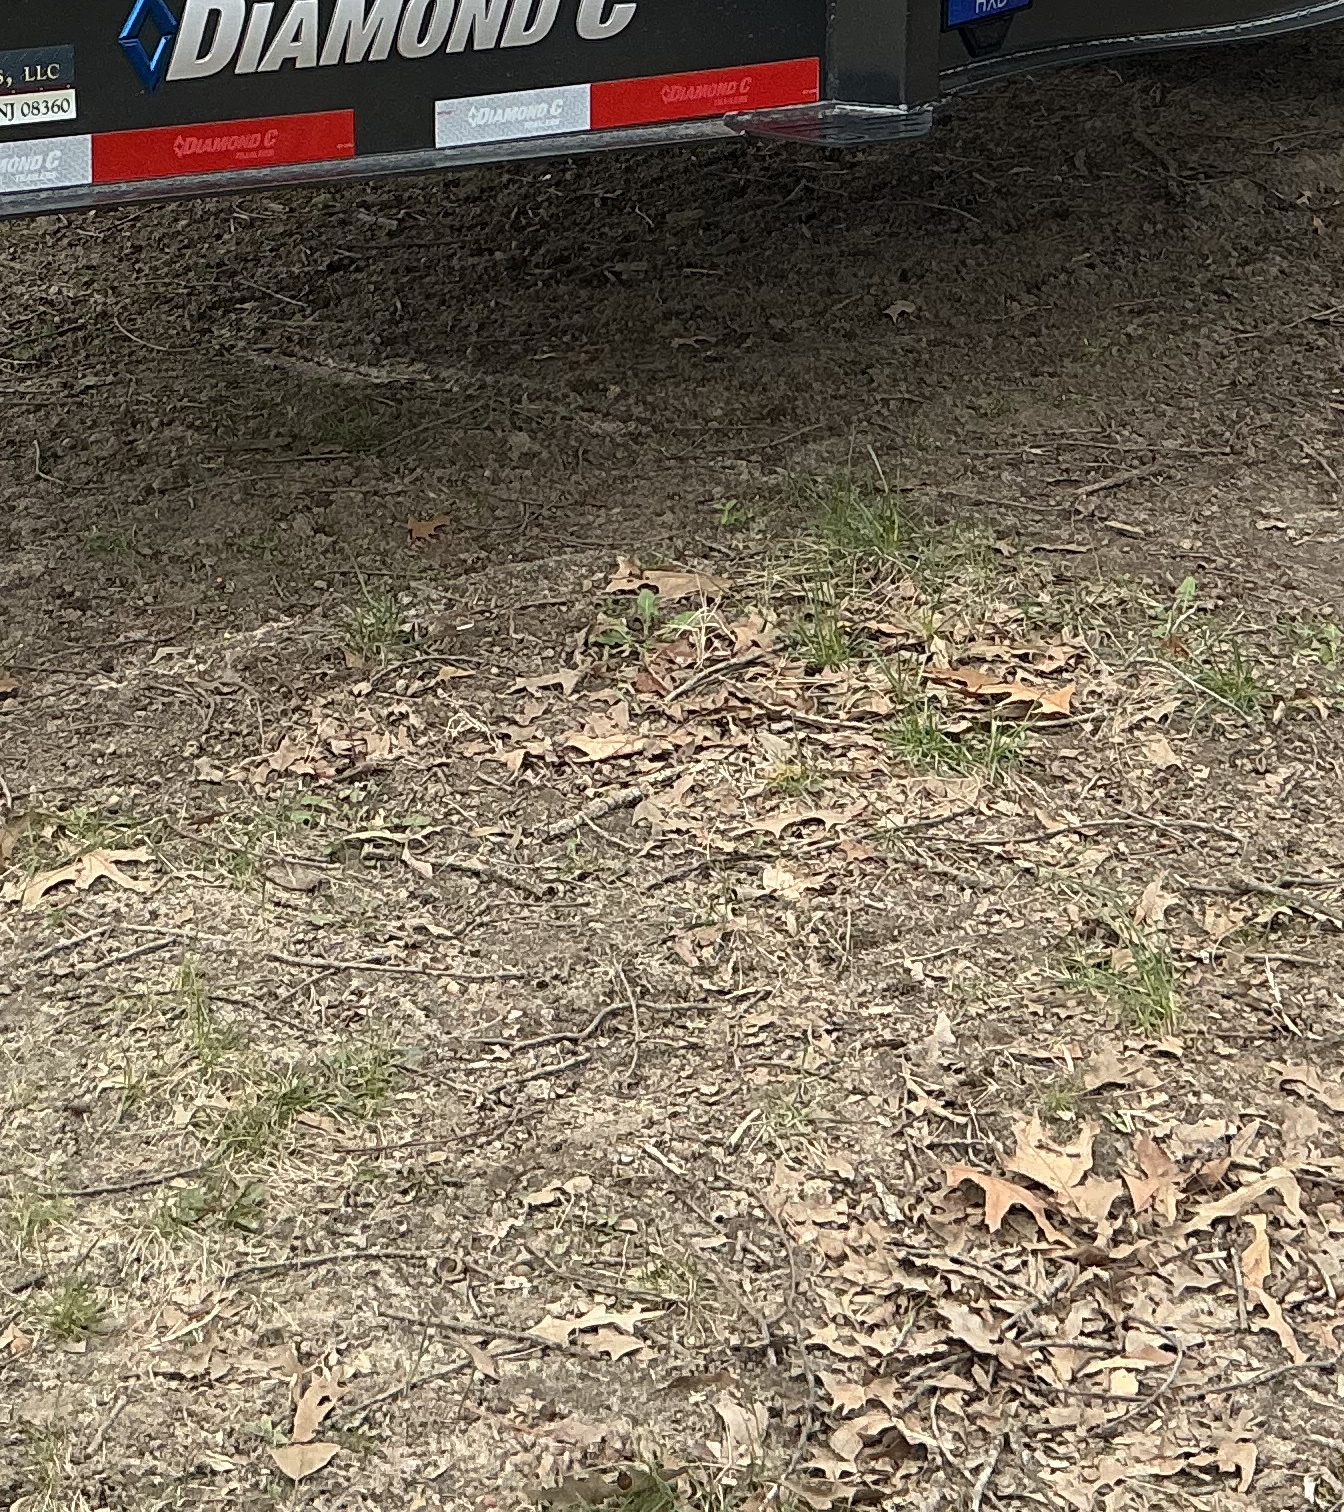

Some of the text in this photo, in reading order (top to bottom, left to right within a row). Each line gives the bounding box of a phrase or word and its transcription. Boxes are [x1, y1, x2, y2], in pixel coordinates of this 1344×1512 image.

[23, 63, 61, 82] LLC
[20, 97, 71, 118] 08360
[476, 103, 549, 126] DIAMOND
[183, 133, 262, 155] DIAMOND
[45, 149, 62, 170] C
